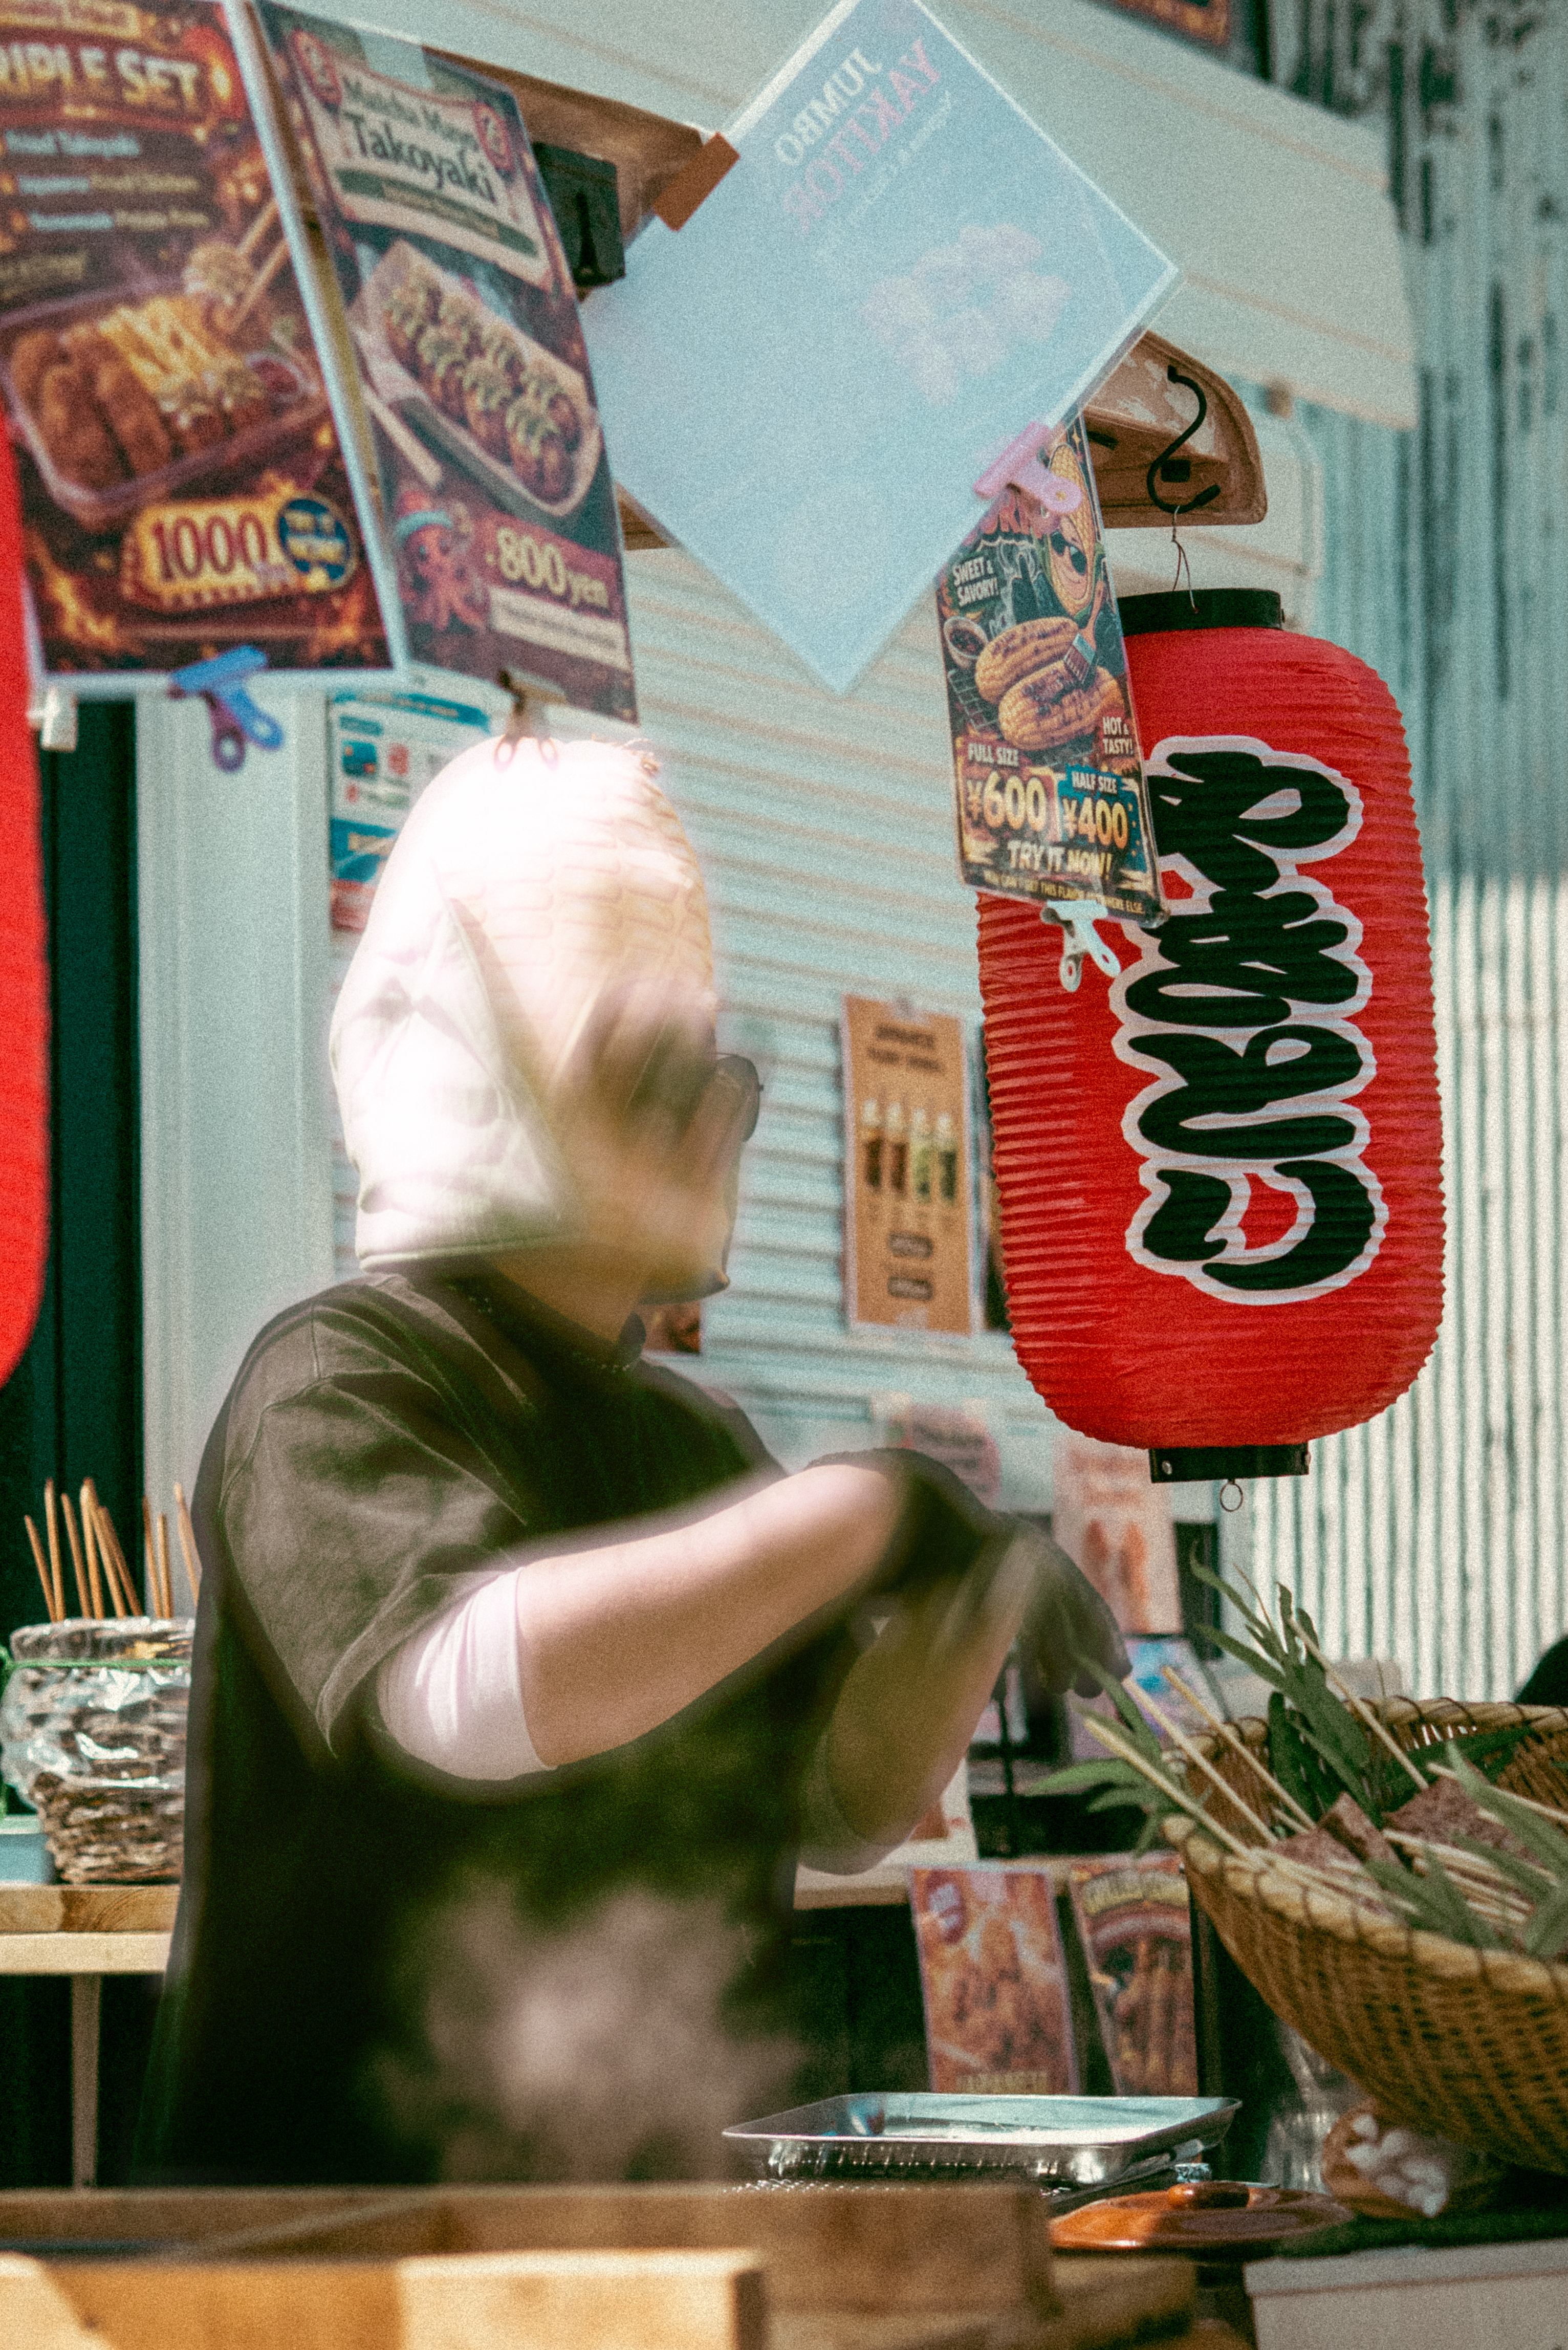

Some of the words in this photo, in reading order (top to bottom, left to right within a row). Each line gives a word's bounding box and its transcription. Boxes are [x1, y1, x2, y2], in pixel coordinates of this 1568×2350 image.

[115, 50, 200, 112] SET
[342, 109, 497, 205] Takoyaki
[152, 512, 268, 582] 1000
[952, 557, 985, 587] SWEET
[956, 578, 1000, 607] SAVORY!
[1103, 716, 1122, 735] HOT
[968, 743, 994, 764] FULL
[996, 747, 1019, 767] SIZE
[1103, 738, 1135, 755] TASTY!
[1072, 770, 1097, 791] HALF
[1098, 775, 1118, 794] SIZE
[966, 770, 1047, 833] ¥600
[1061, 796, 1128, 849] ¥400
[1007, 840, 1045, 871] TRY
[1047, 845, 1065, 872] IT
[1066, 849, 1113, 881] NOW!
[1040, 881, 1057, 897] THIS
